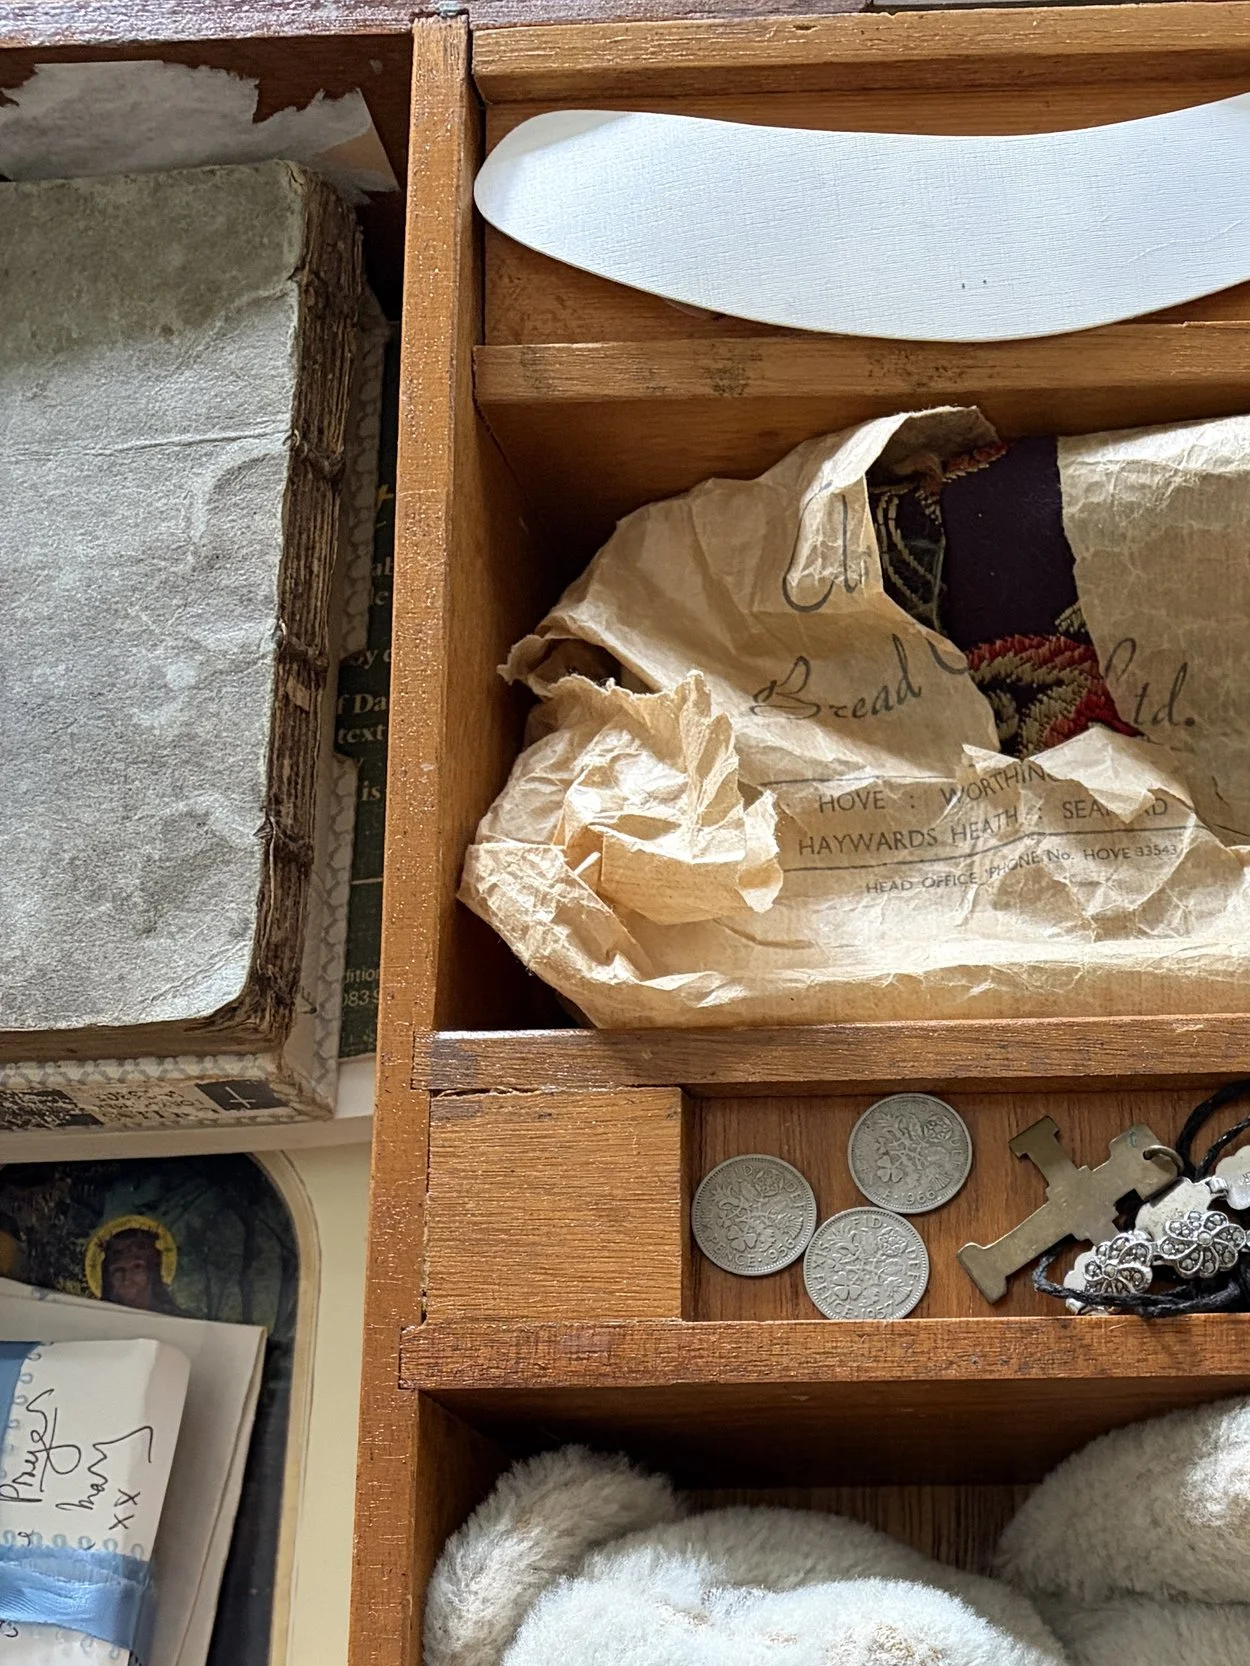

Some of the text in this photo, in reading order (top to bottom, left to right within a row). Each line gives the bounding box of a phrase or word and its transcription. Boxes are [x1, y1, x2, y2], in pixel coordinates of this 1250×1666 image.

[750, 633, 922, 720] Bread
[818, 790, 886, 814] HOVE
[799, 827, 938, 856] HAYWARDS
[951, 806, 1018, 844] HEATH
[866, 879, 912, 894] HEAD
[922, 871, 977, 889] OFFICE
[1046, 848, 1075, 861] No.
[1083, 847, 1131, 860] HOVE
